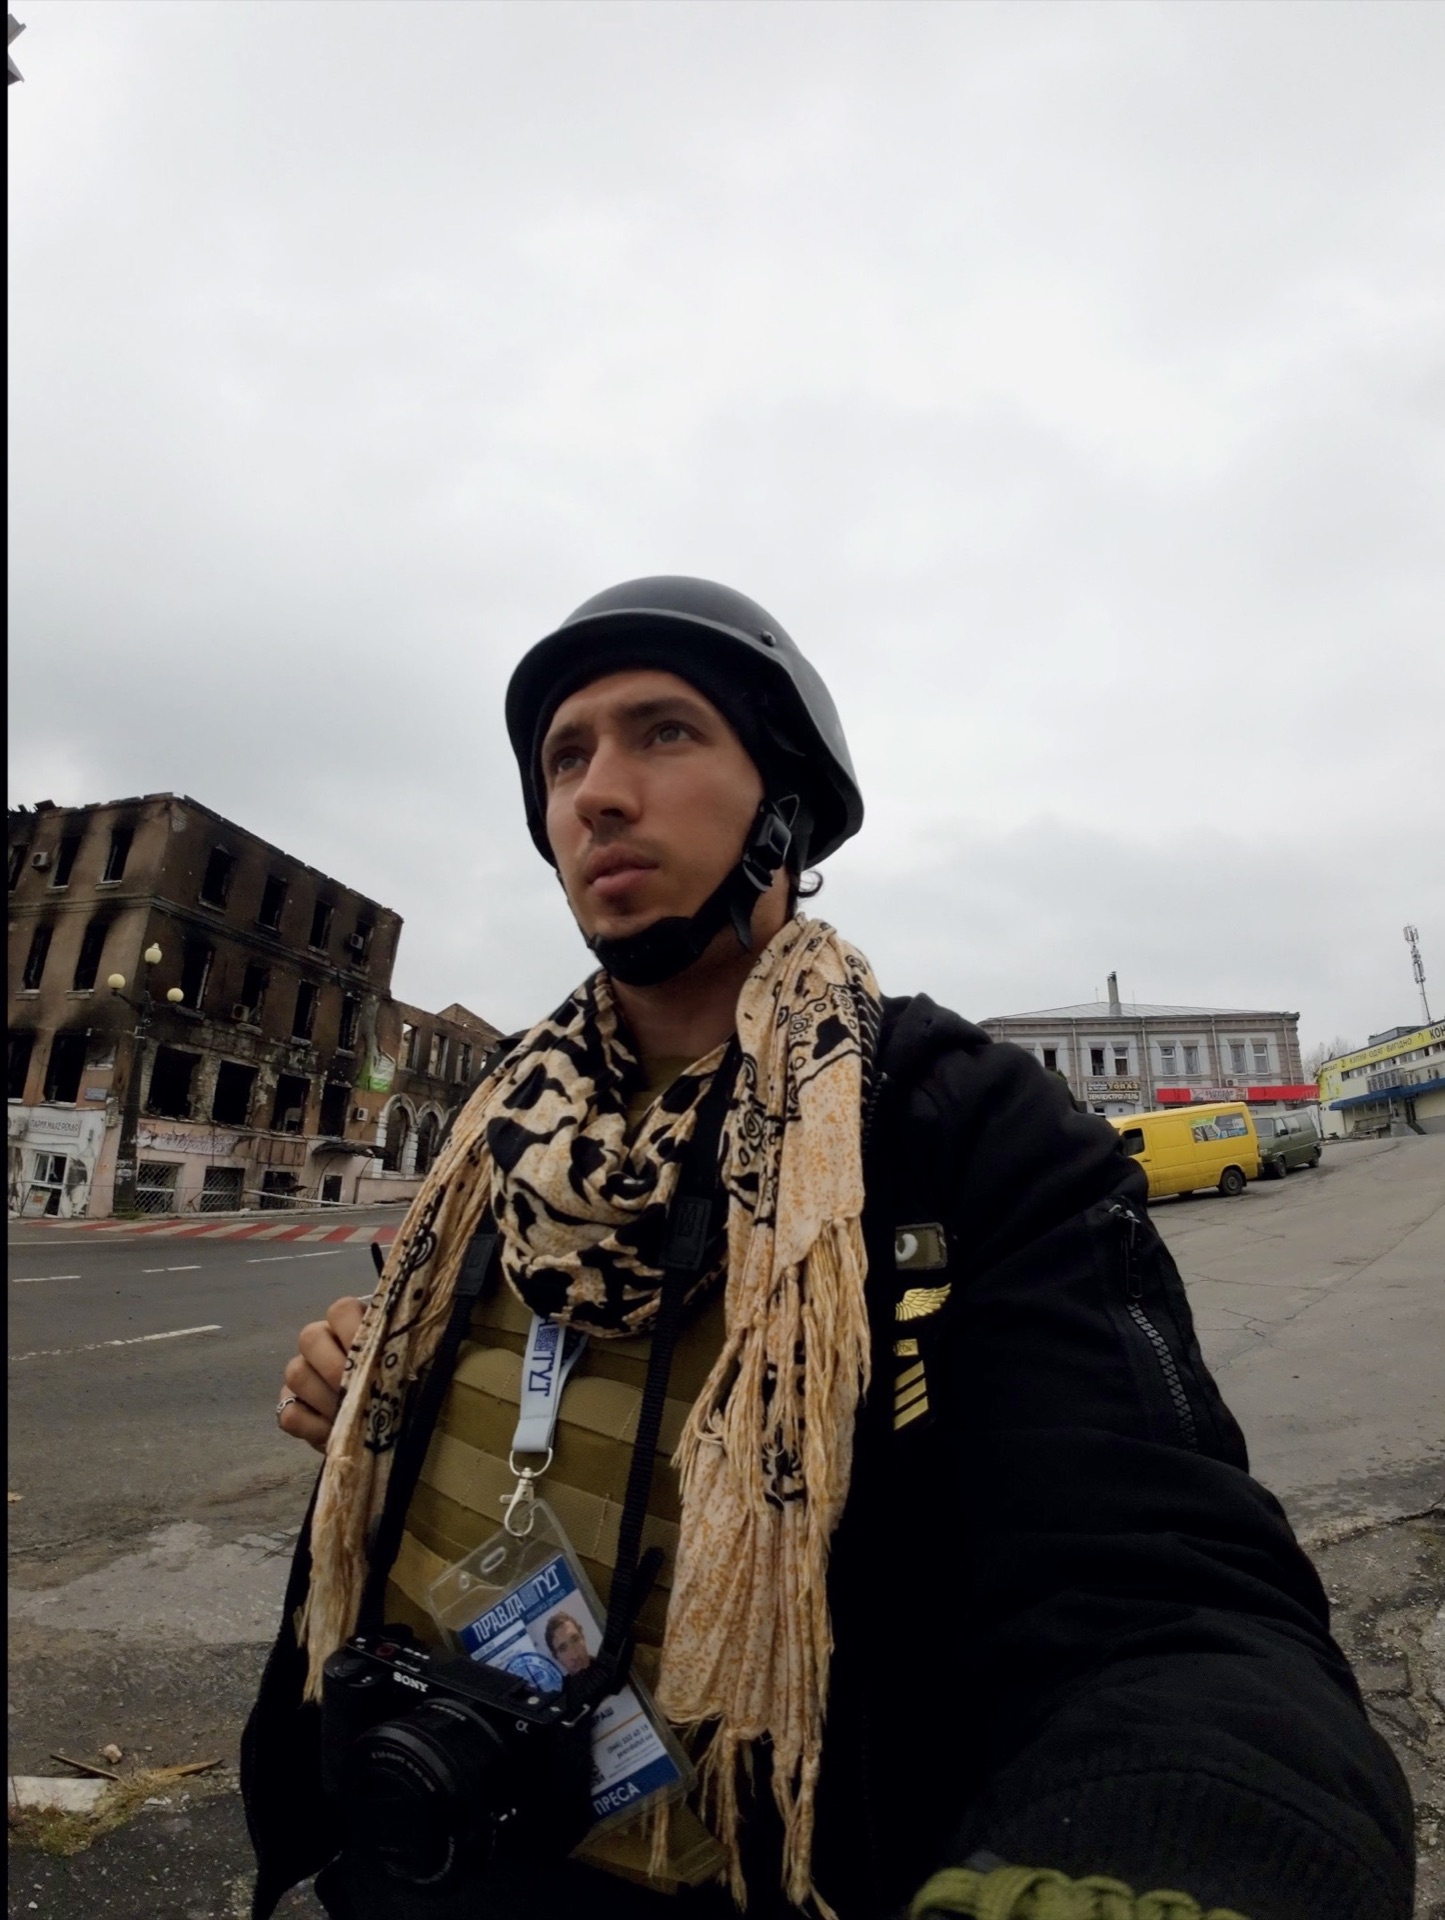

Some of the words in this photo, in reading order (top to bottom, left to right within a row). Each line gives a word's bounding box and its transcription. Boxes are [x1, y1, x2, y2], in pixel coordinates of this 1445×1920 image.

[471, 1593, 527, 1643] ПРАВДА
[393, 1671, 430, 1693] SONY
[592, 1781, 641, 1816] ПРЕСА
